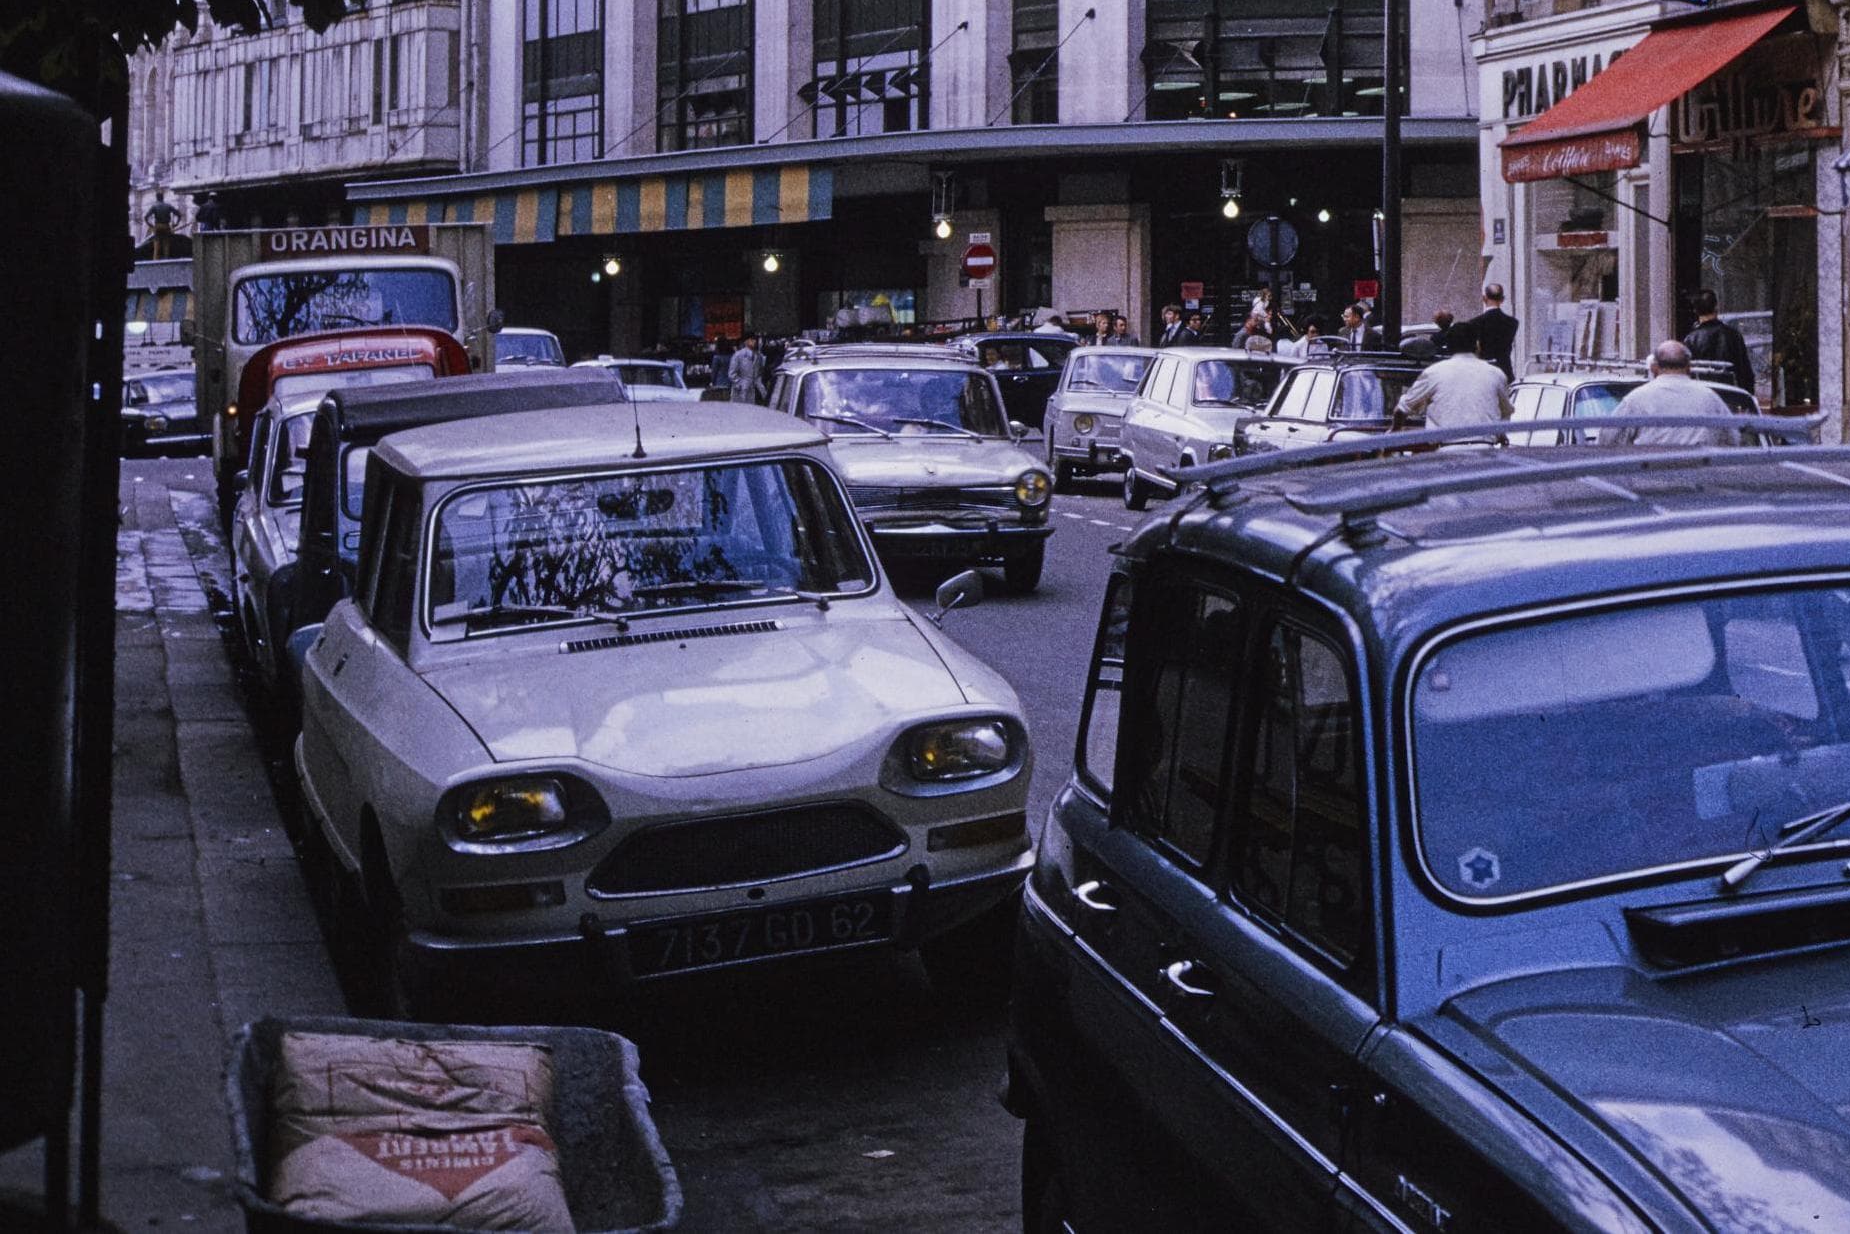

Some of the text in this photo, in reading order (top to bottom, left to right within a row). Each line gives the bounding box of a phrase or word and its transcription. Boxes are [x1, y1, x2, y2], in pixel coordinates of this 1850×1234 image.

[270, 227, 417, 252] ORANGINA
[657, 918, 749, 967] 7137
[830, 901, 875, 939] 62
